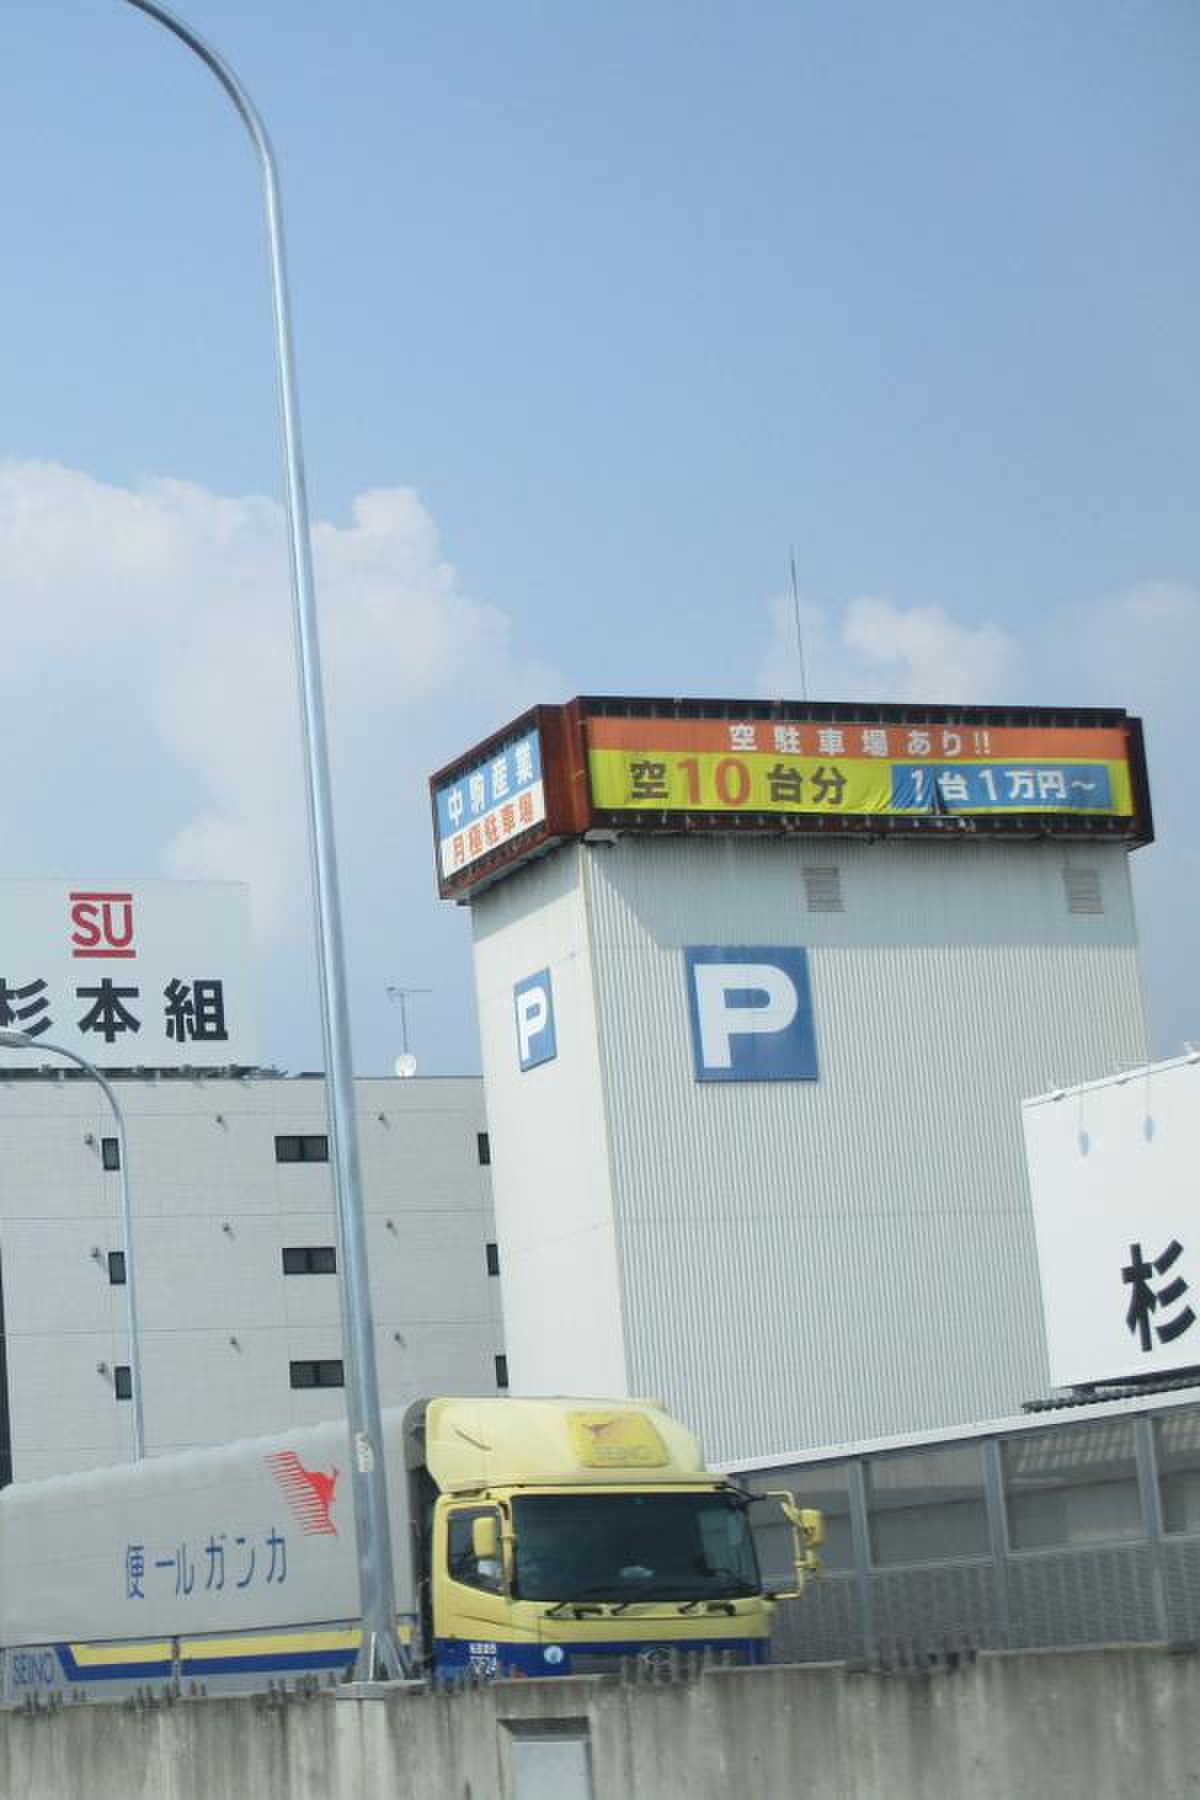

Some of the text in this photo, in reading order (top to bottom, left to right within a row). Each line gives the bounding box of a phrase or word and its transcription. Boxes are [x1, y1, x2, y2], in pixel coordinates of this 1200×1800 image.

[630, 758, 848, 807] 空10台分
[70, 901, 134, 948] SU
[516, 986, 548, 1062] P
[693, 963, 799, 1069] P
[1119, 1238, 1198, 1353] 杉
